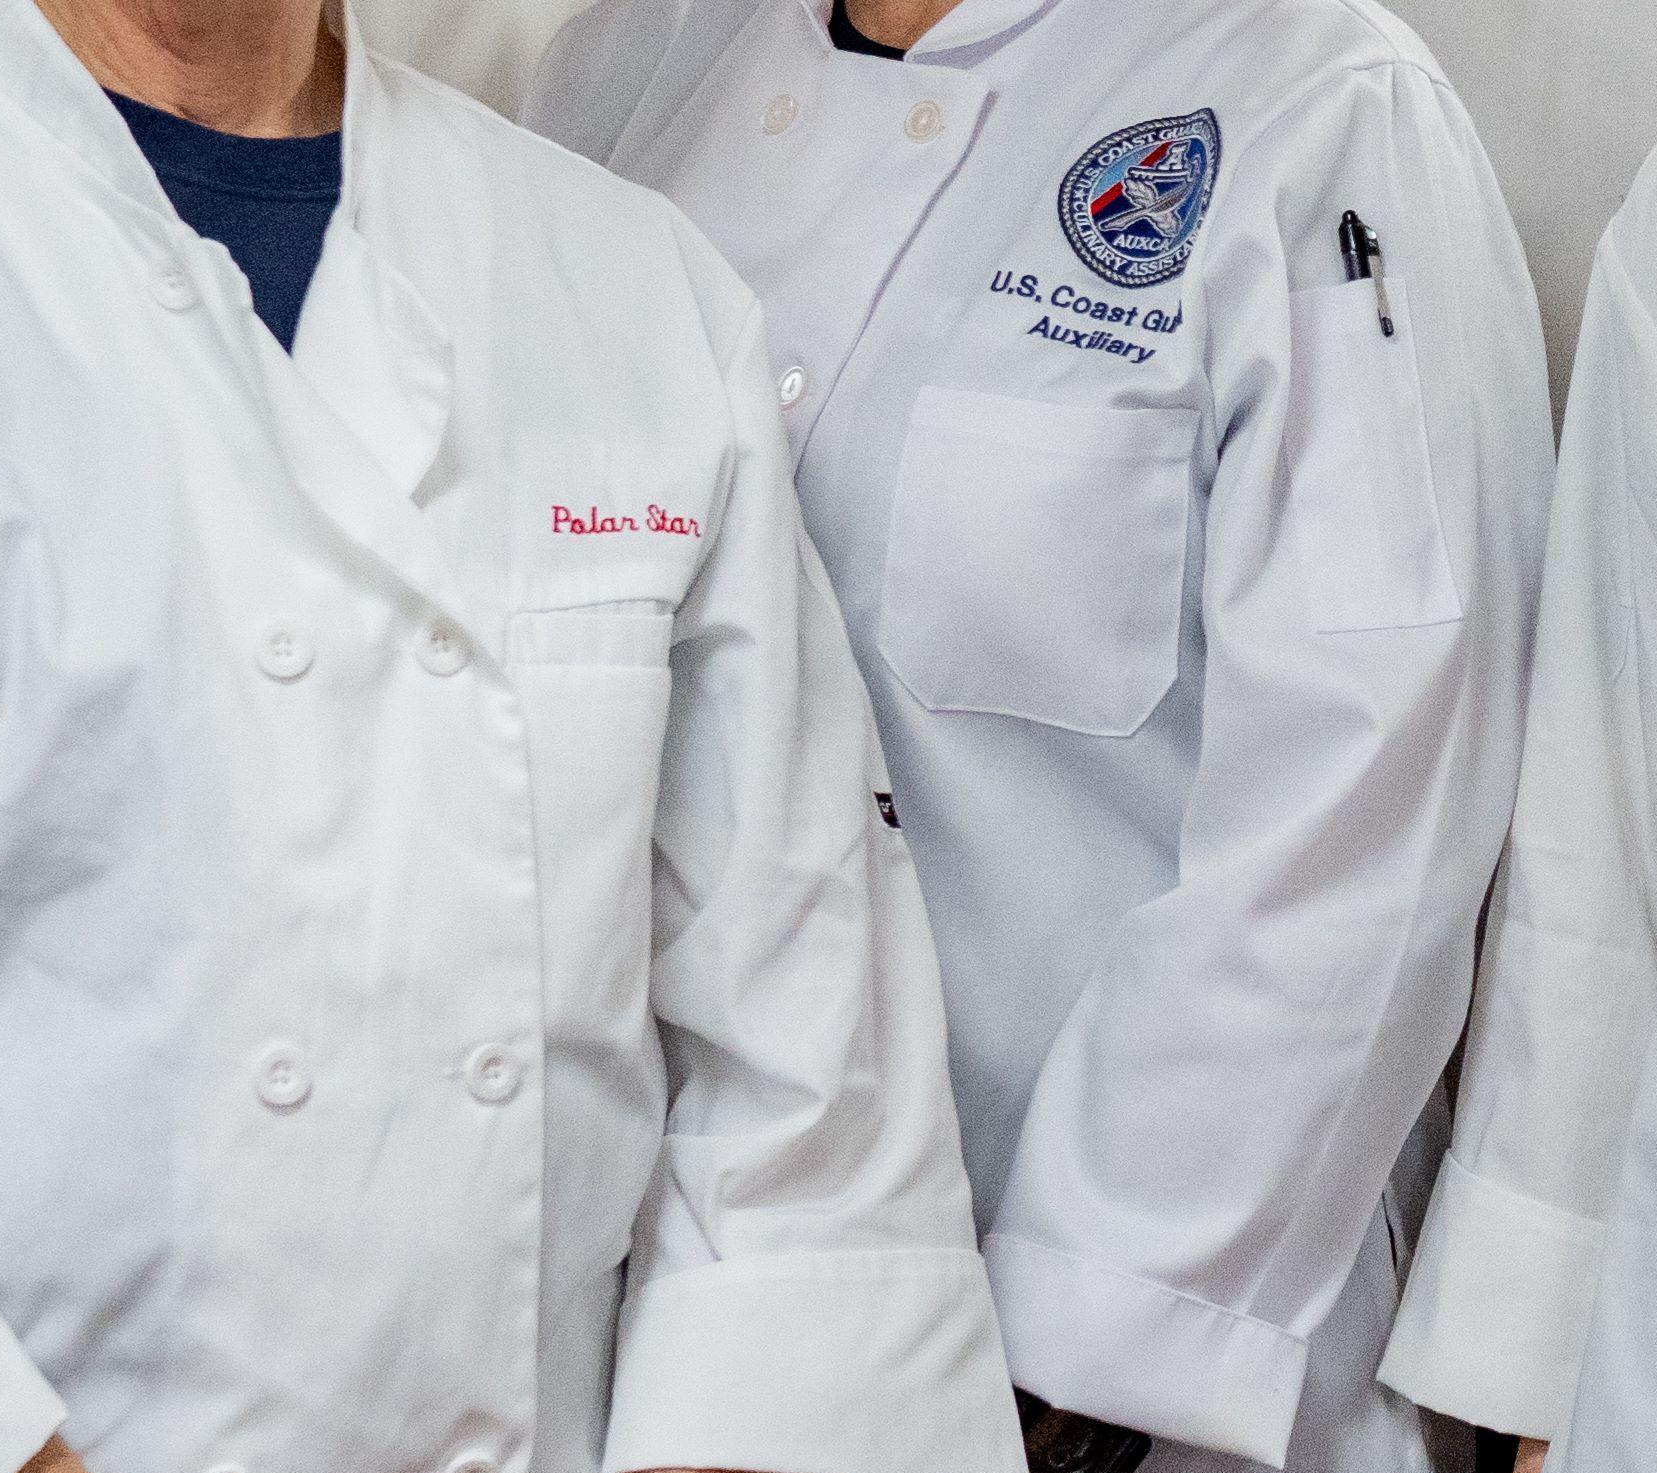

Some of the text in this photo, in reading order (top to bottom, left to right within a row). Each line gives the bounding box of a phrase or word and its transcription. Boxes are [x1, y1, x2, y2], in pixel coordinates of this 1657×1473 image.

[990, 270, 1042, 303] U.S.
[1050, 285, 1139, 326] Coast
[1026, 315, 1156, 364] Auxiliary
[552, 504, 702, 538] Polar Star
